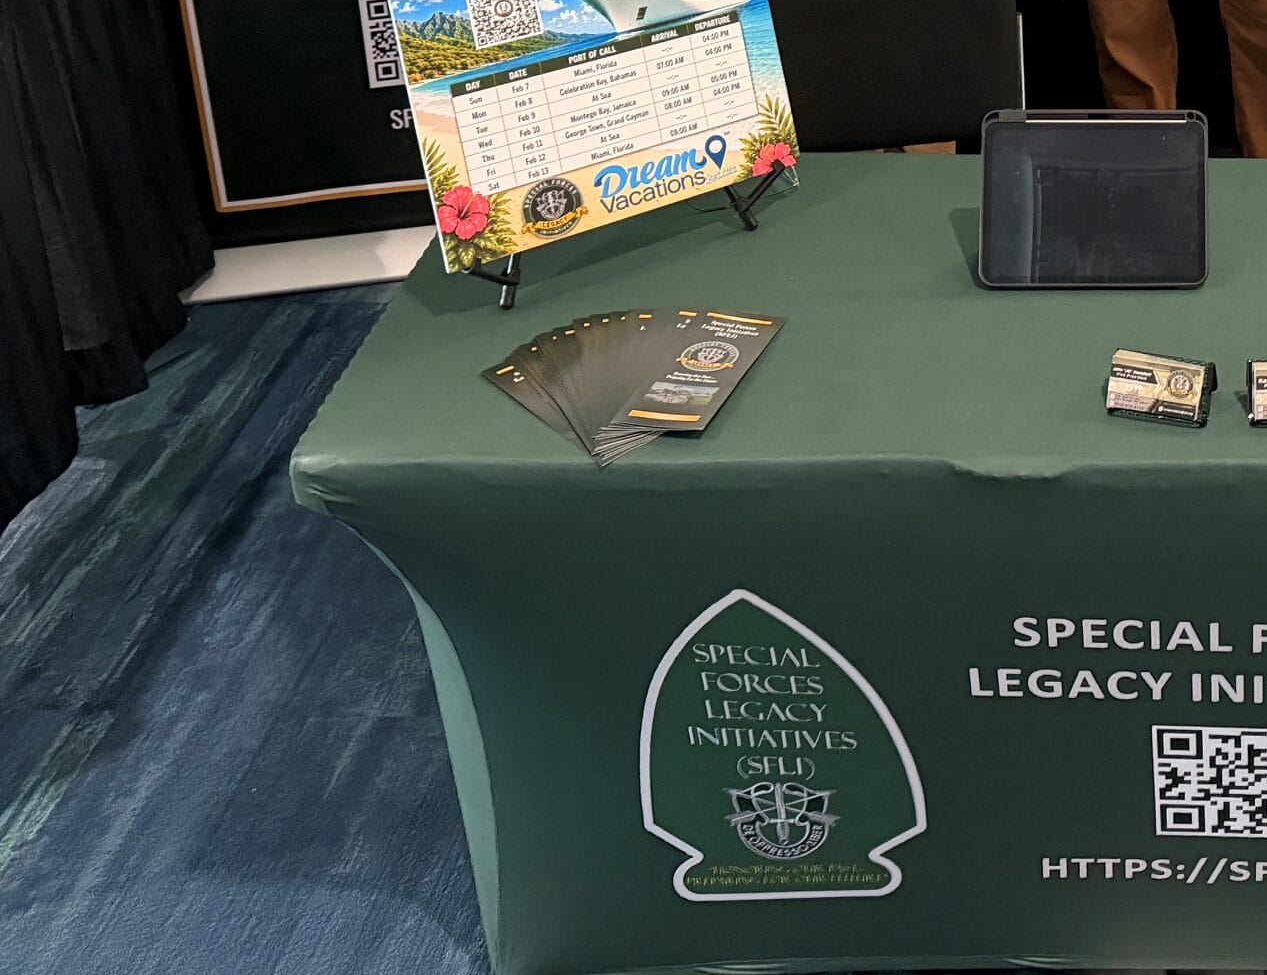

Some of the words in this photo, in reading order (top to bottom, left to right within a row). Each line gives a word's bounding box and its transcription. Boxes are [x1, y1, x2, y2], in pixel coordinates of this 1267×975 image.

[465, 80, 481, 92] DAY
[508, 68, 528, 80] DATE
[568, 51, 586, 64] PORT
[588, 50, 598, 59] OF
[600, 46, 617, 56] CALL
[651, 28, 678, 43] ARRIVAL
[694, 15, 732, 32] DEPARTURE
[469, 96, 482, 106] Sun
[512, 84, 524, 94] Feb
[574, 67, 596, 78] Miami,
[596, 60, 618, 72] Florida
[472, 110, 486, 120] Mon
[515, 99, 527, 108] Feb
[559, 81, 596, 96] Celebration
[610, 70, 638, 82] Bahamas
[476, 125, 488, 134] Tue
[518, 114, 530, 124] Feb
[600, 92, 612, 100] Sea
[478, 139, 492, 148] Wed
[519, 128, 532, 138] Feb
[570, 109, 597, 124] Montego
[612, 99, 636, 112] Jamaica
[482, 153, 495, 163] Thu
[522, 142, 535, 152] Feb
[565, 128, 588, 140] George
[606, 117, 624, 128] Grand
[626, 110, 650, 124] Cayman
[486, 168, 496, 176] Fri
[526, 156, 538, 166] Feb
[608, 132, 620, 141] Sea
[488, 182, 500, 191] Sat
[528, 170, 540, 180] Feb
[591, 150, 612, 161] Miami,
[612, 142, 634, 154] Florida
[594, 148, 707, 198] Dream
[542, 216, 568, 228] LEGACY
[693, 643, 820, 668] SPECIAL
[1012, 617, 1233, 652] SPECIAL
[700, 671, 824, 696] FORCES
[968, 667, 1173, 702] LEGACY
[704, 699, 827, 722] LEGACY
[687, 726, 858, 750] INITIATIVES
[736, 755, 816, 780] (SFLI)
